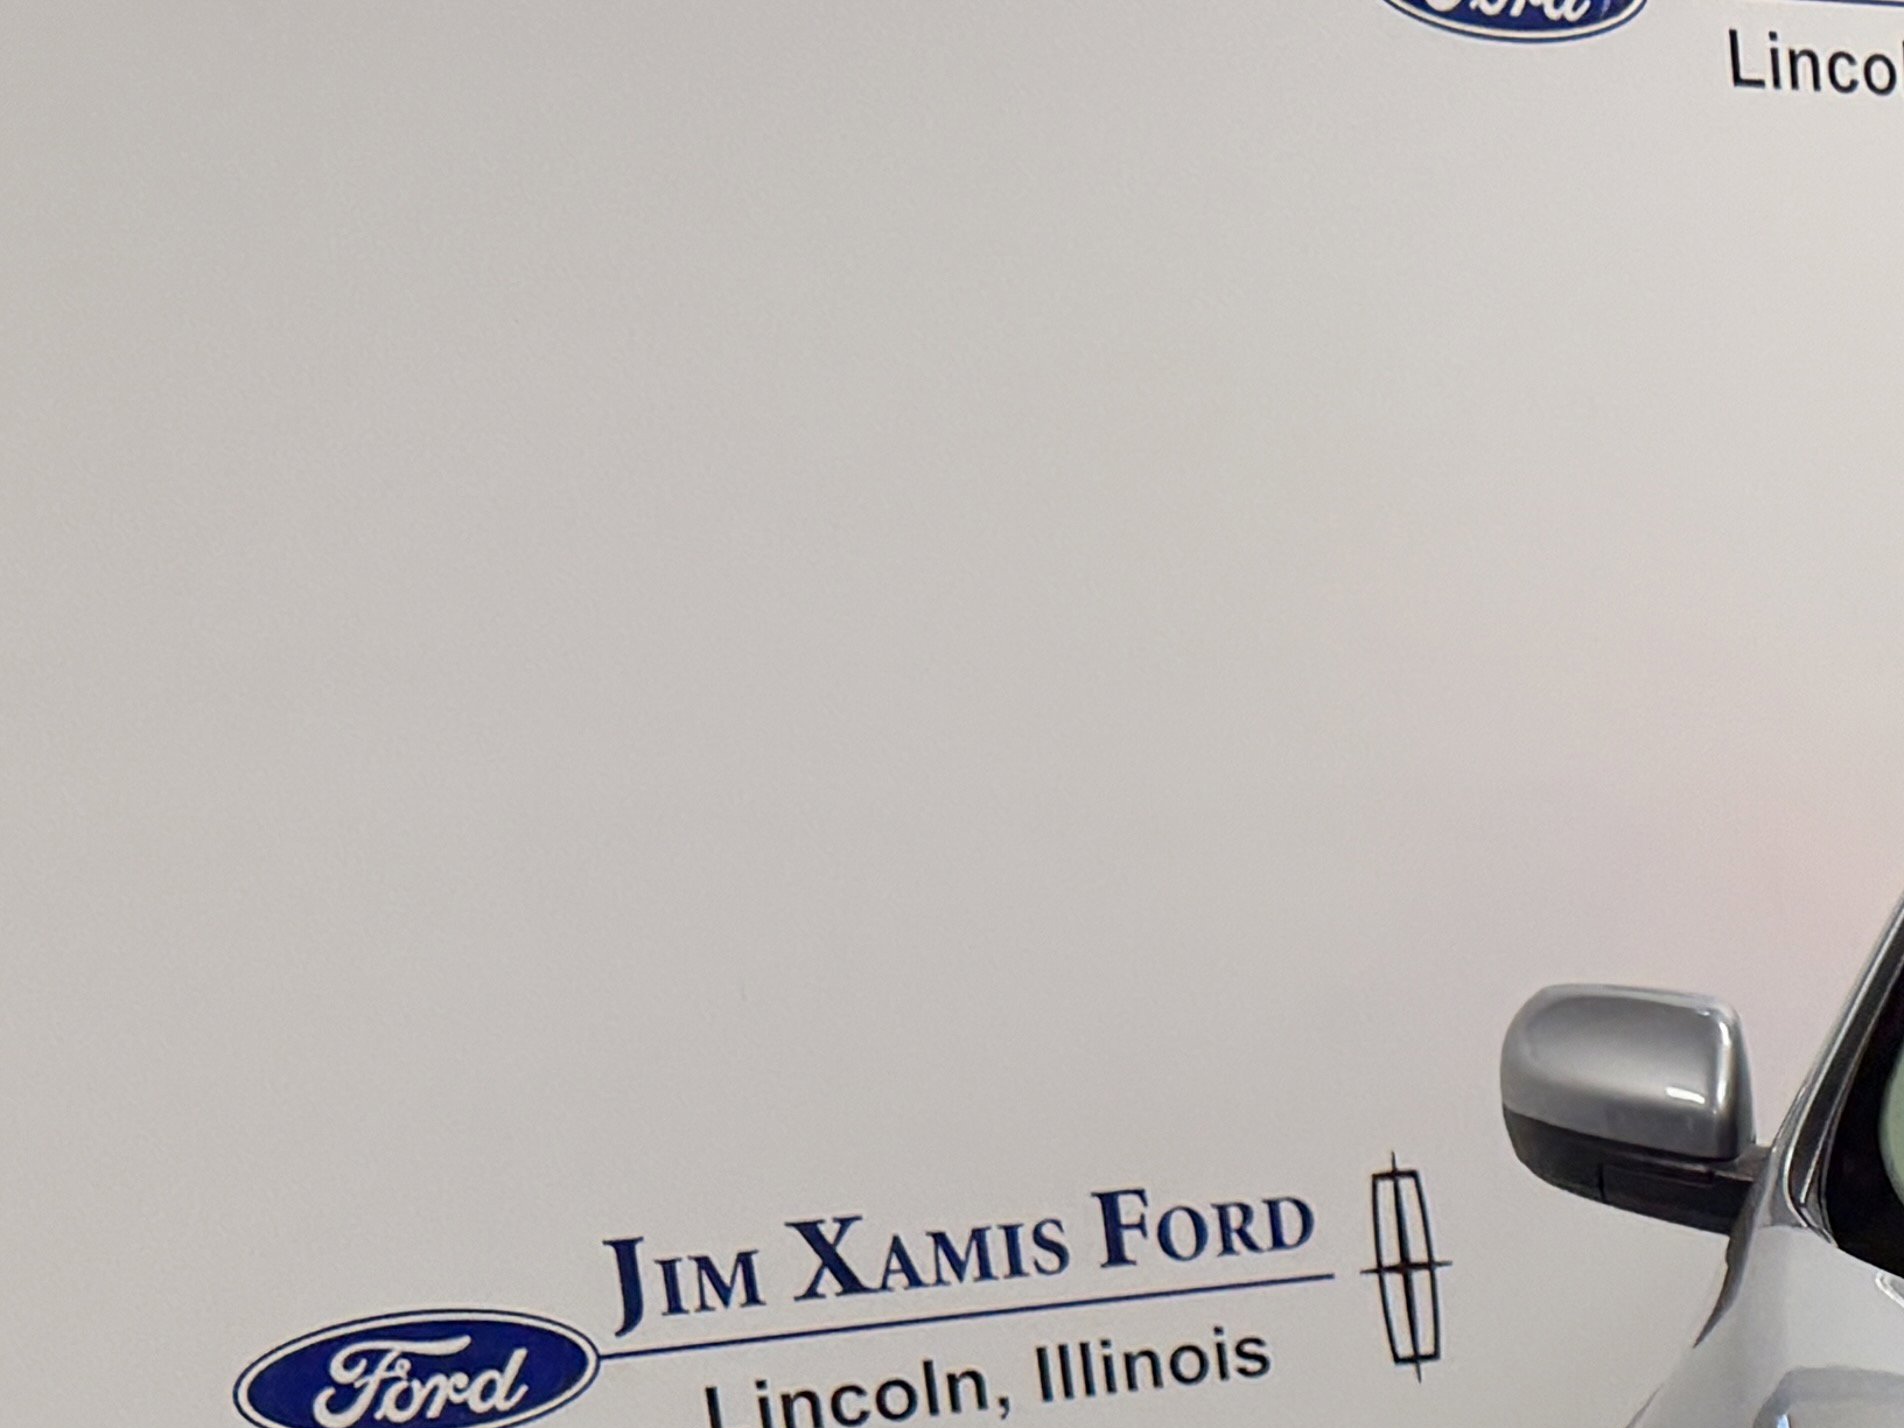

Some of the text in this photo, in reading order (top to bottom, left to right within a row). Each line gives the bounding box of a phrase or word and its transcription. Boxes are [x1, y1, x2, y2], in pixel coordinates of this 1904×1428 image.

[601, 1187, 1315, 1339] JIM XAMIS FORD
[1036, 1327, 1273, 1403] Illinois
